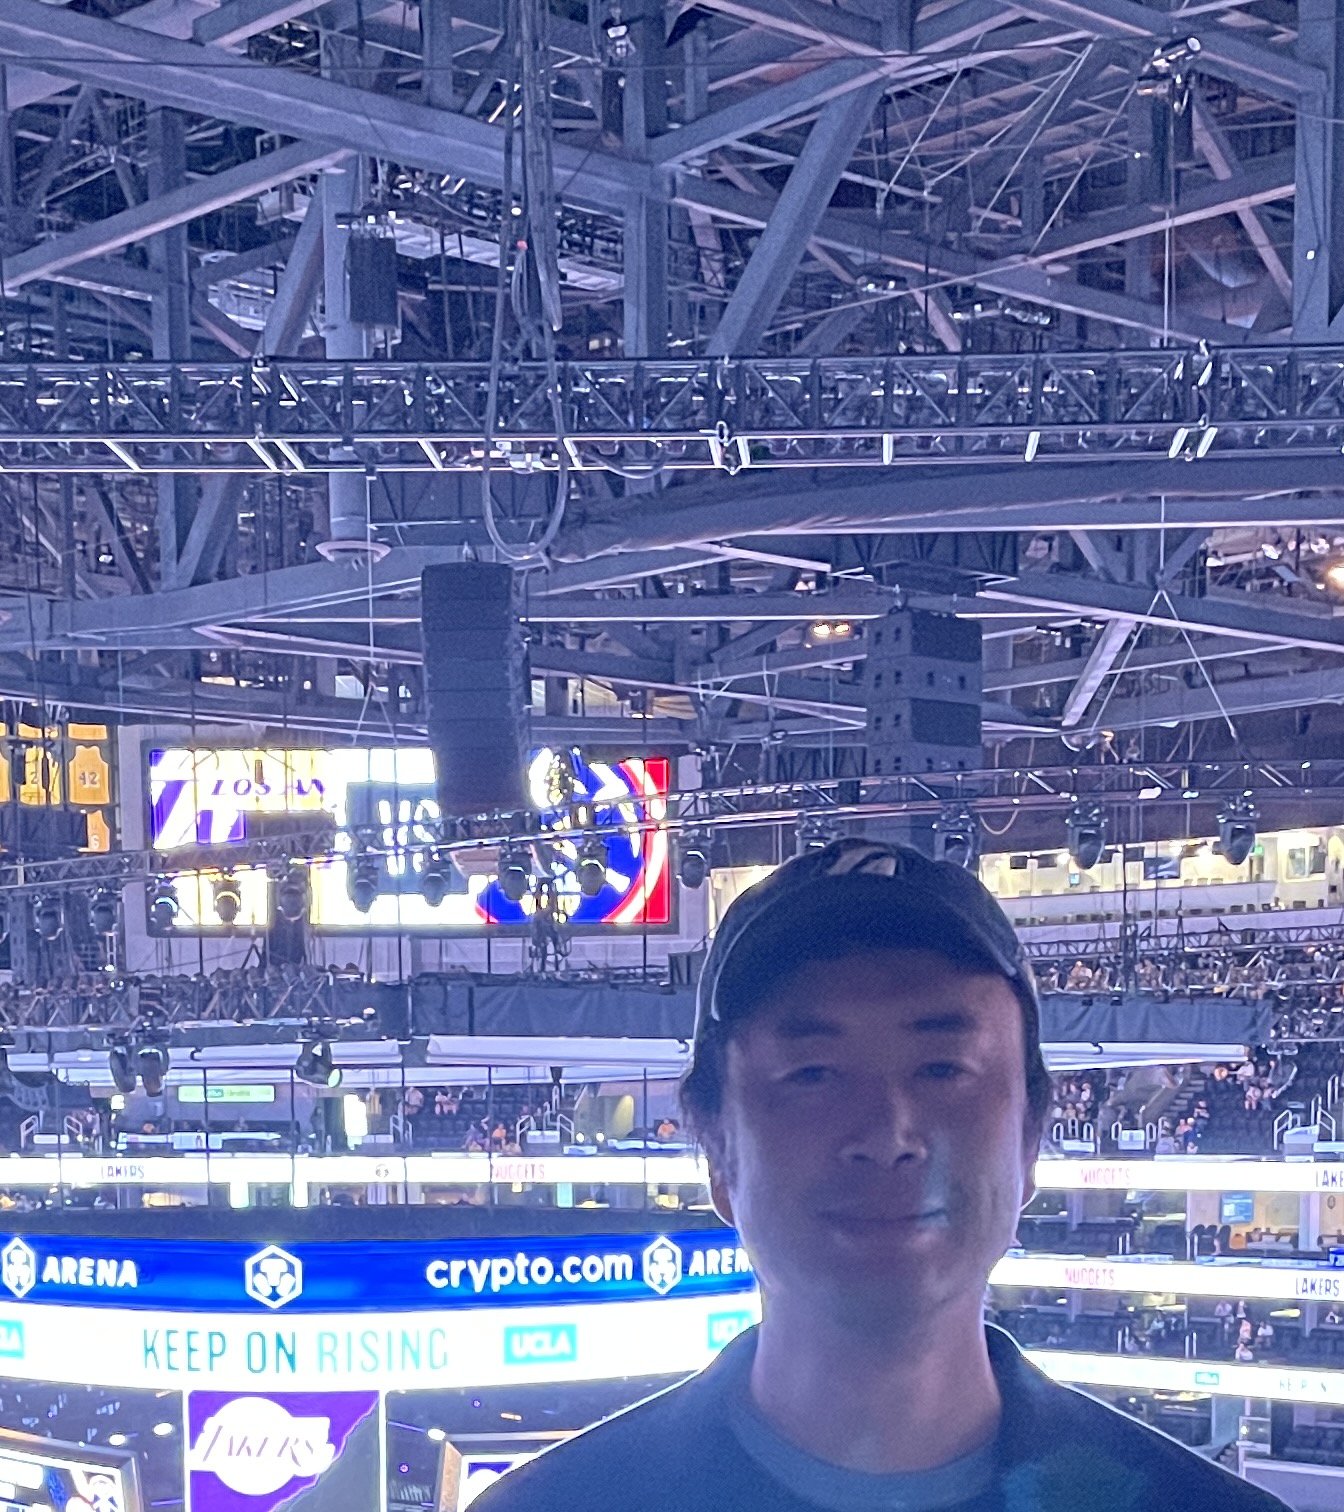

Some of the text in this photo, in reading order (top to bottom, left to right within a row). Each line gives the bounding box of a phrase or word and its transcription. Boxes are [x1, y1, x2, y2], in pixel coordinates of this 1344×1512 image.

[211, 778, 272, 796] LOS
[100, 1163, 146, 1180] LAKERS
[489, 1162, 545, 1180] NUGGETS
[1080, 1167, 1131, 1186] NUGGETS
[42, 1256, 138, 1288] ARENA
[425, 1252, 634, 1293] crypto.com
[1064, 1267, 1115, 1287] NUGGETS
[1295, 1277, 1341, 1298] LAKERS
[142, 1328, 449, 1374] KEEP ON RISING
[511, 1332, 572, 1357] UCLA
